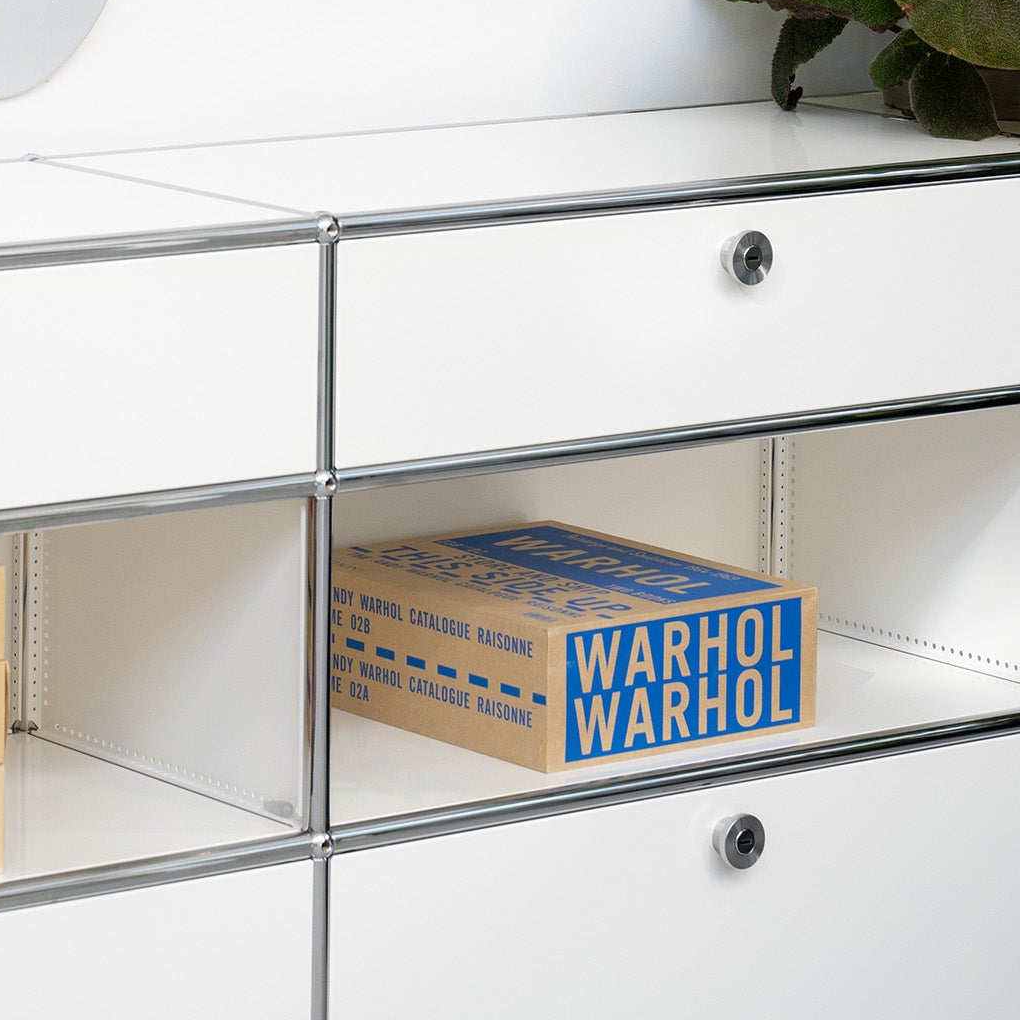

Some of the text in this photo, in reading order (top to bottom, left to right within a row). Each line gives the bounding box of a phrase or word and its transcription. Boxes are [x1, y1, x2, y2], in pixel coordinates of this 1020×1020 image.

[380, 545, 473, 570] THIS
[471, 571, 570, 597] SIDE
[566, 596, 632, 611] UP
[453, 554, 610, 595] STORE AND SHIP
[493, 535, 712, 595] WARHOL
[333, 586, 354, 607] NDY
[360, 593, 403, 621] WARHOL
[409, 608, 471, 641] CATALOGUE
[477, 627, 533, 659] RAISONNE
[351, 614, 370, 634] 02B
[574, 604, 794, 694] WARHOL
[333, 653, 353, 673] NDY
[359, 661, 402, 689] WARHOL
[409, 676, 470, 710] CATALOGUE
[477, 696, 533, 728] RAISONNE
[350, 681, 369, 701] 02A
[574, 665, 793, 756] WARHOL
